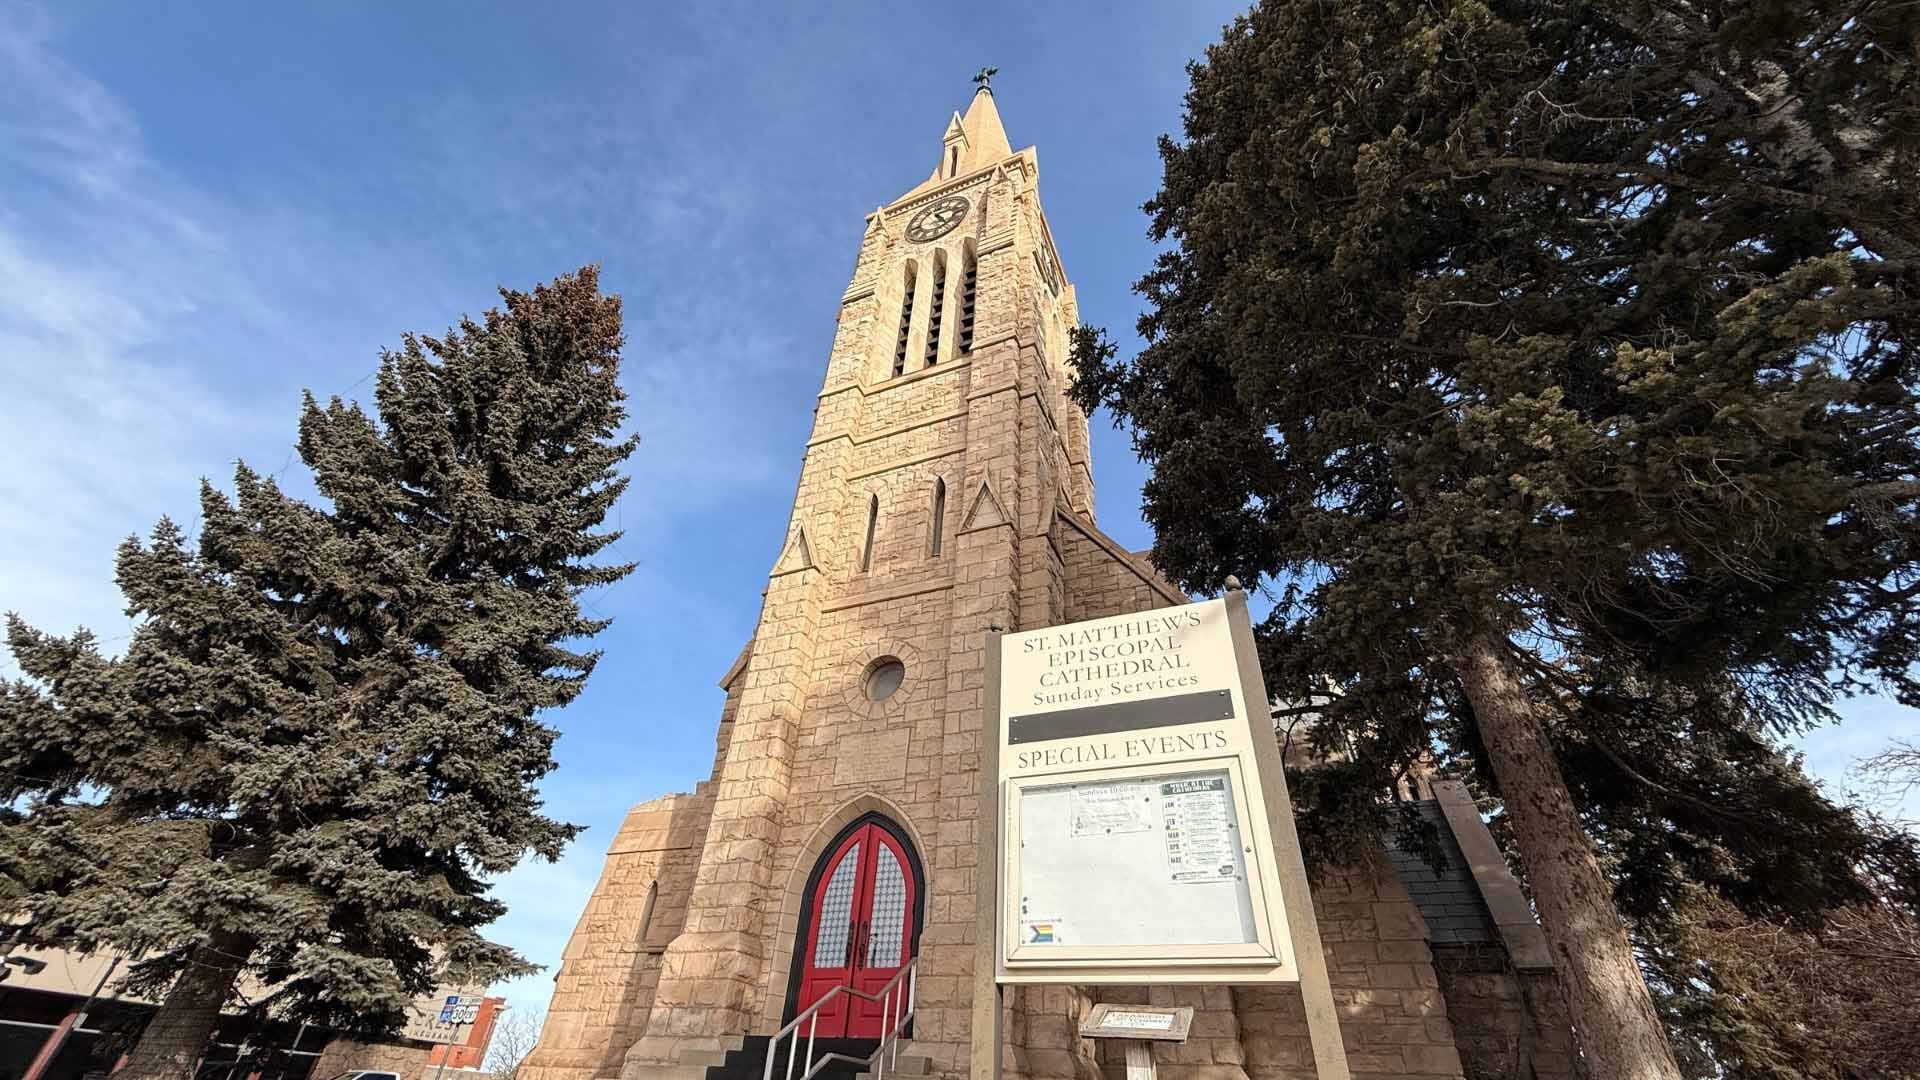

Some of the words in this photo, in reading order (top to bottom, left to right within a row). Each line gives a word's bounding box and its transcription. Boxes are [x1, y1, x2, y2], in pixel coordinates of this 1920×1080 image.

[1023, 637, 1051, 654] ST.
[1058, 611, 1202, 648] MATTHEW'S
[1048, 635, 1182, 668] EPISCOPAL
[1039, 653, 1190, 688] CATHEDRAL
[1033, 684, 1104, 706] Sunday
[1111, 673, 1199, 696] Services
[1018, 743, 1116, 769] SPECIAL
[1126, 730, 1228, 757] EVENTS
[452, 1009, 464, 1019] 30
